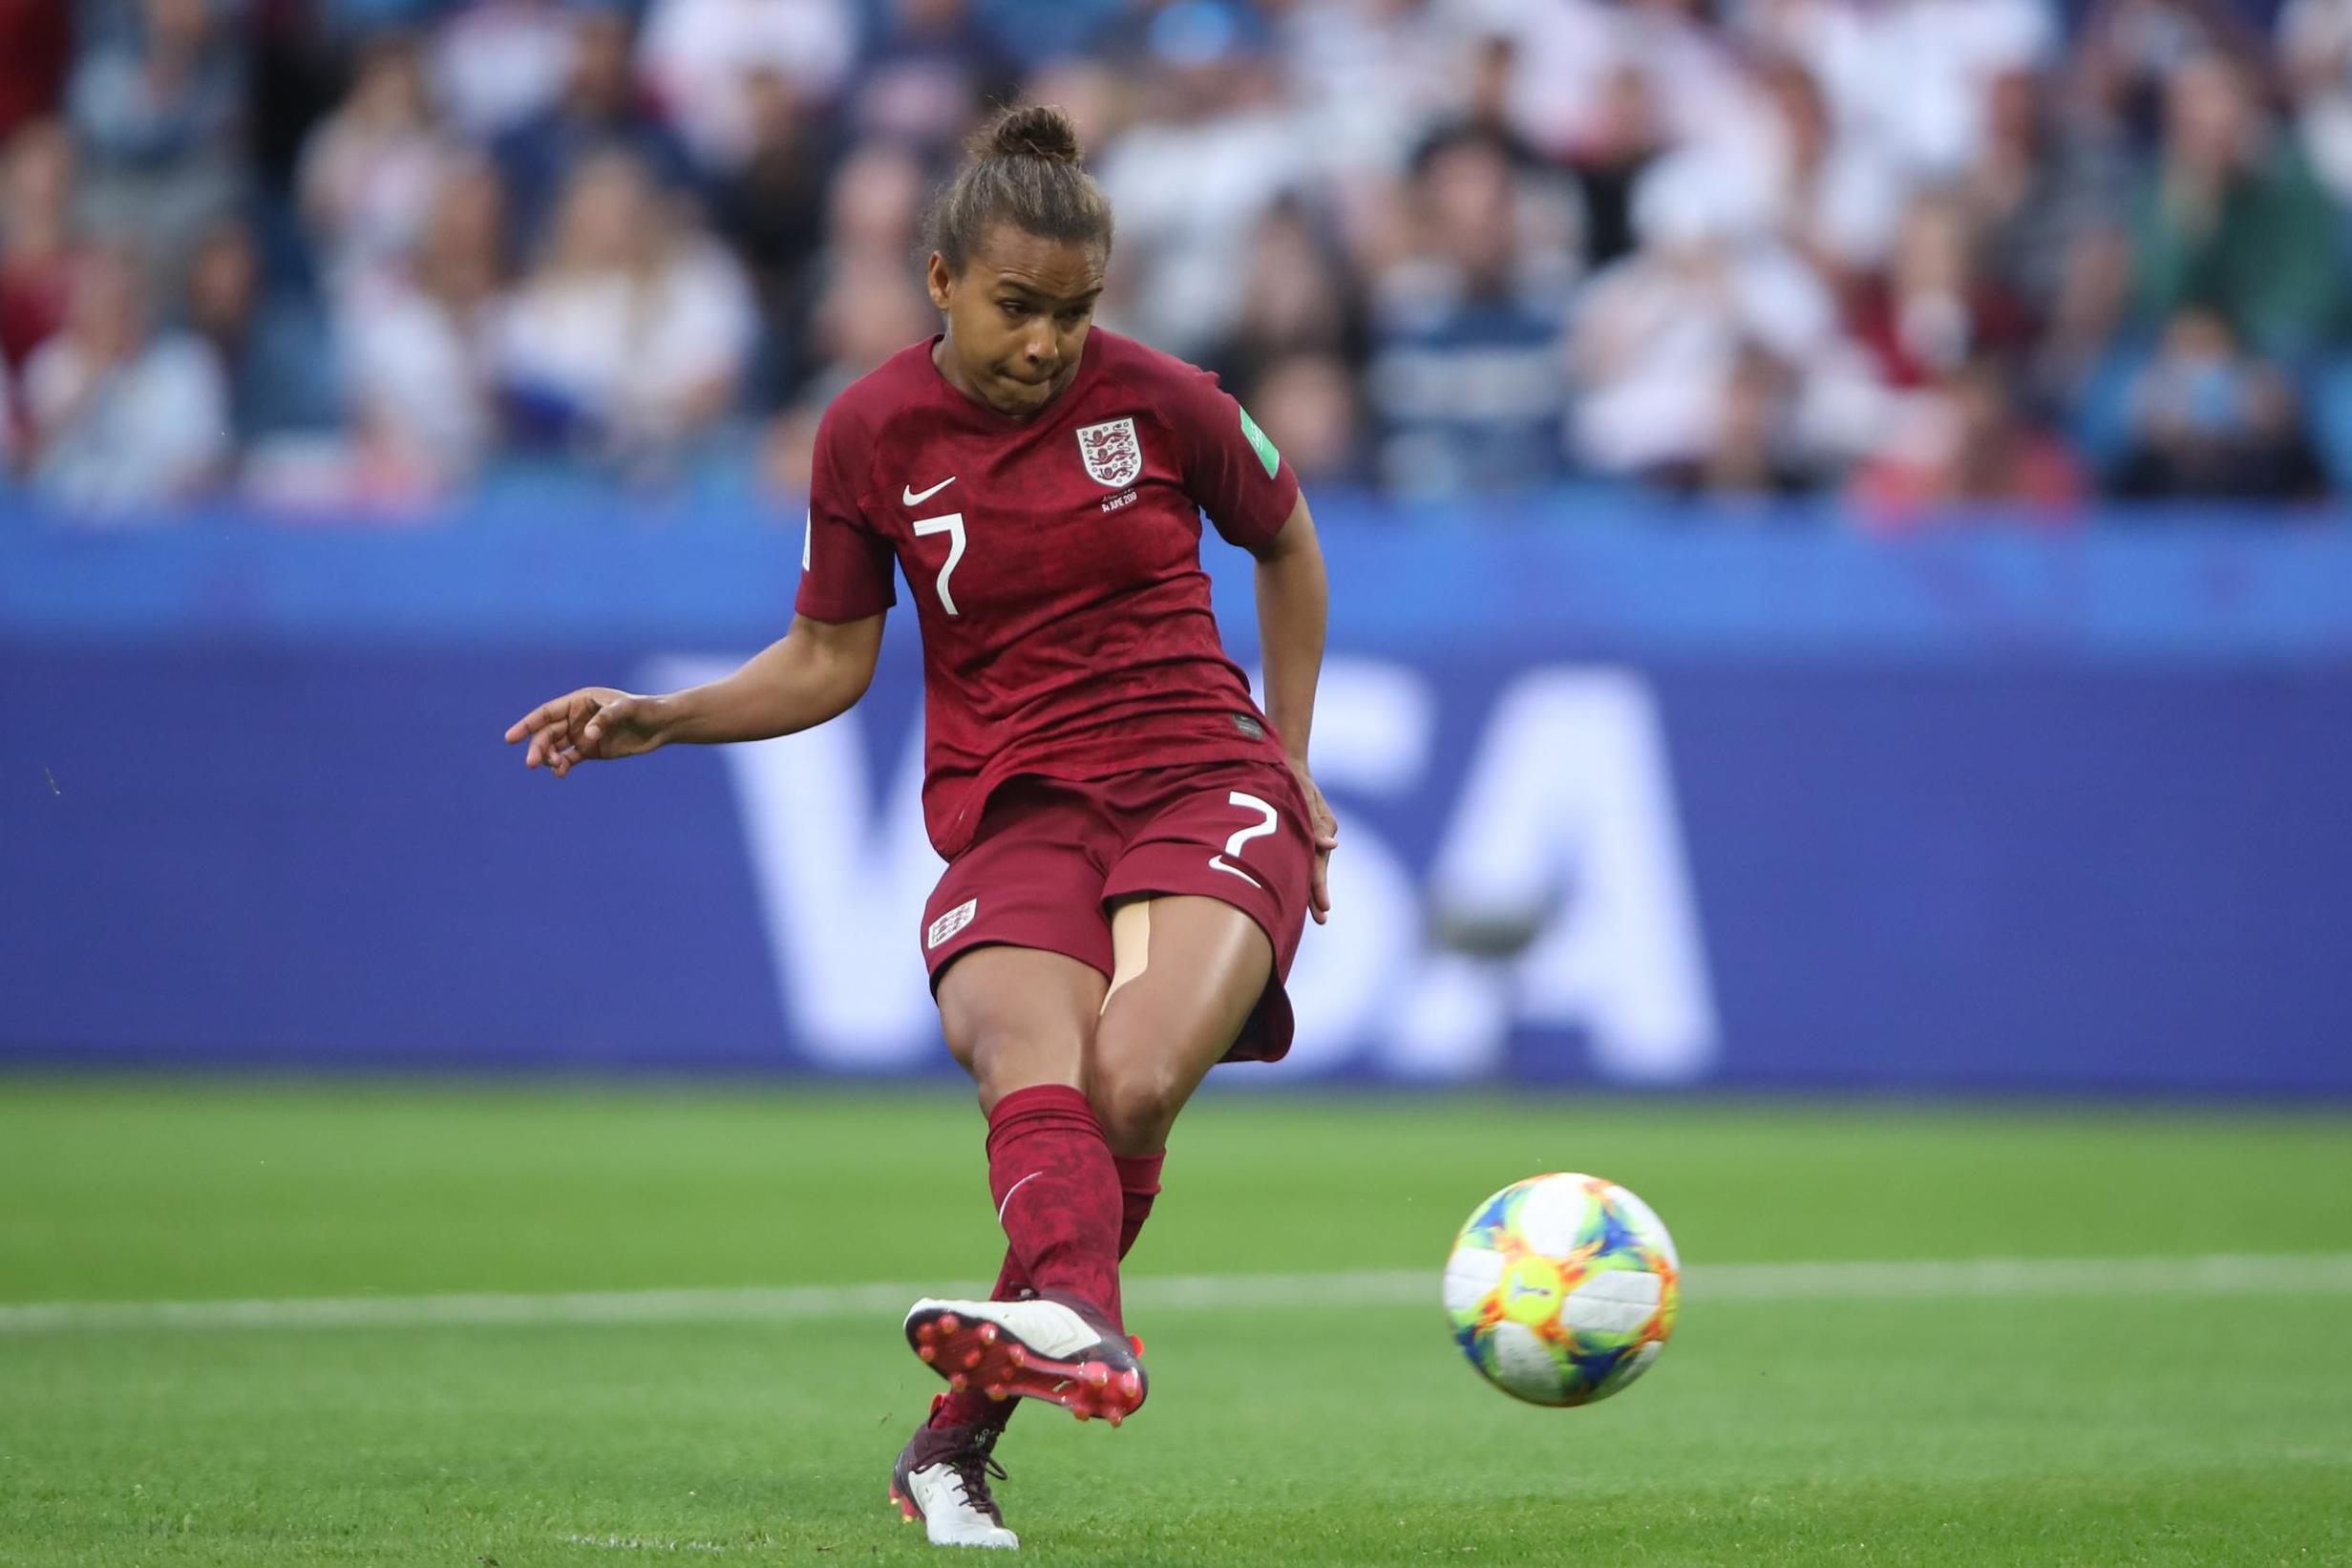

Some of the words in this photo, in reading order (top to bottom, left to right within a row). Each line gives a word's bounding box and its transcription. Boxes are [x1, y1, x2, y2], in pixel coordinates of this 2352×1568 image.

[913, 513, 966, 615] 7
[659, 659, 1719, 1077] VSA
[1225, 791, 1278, 858] 7
